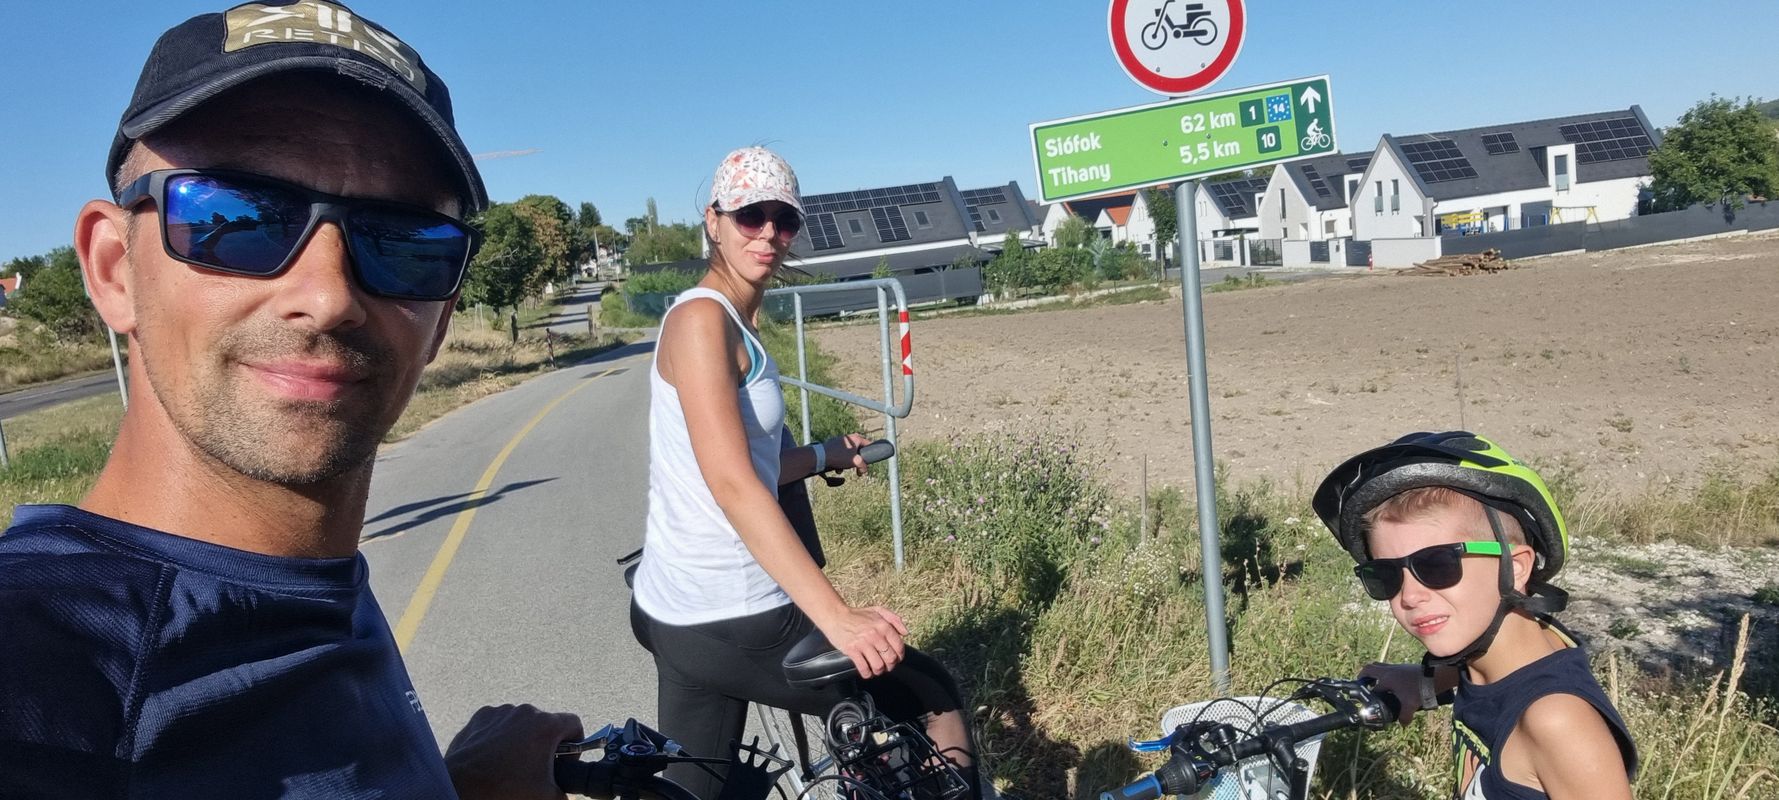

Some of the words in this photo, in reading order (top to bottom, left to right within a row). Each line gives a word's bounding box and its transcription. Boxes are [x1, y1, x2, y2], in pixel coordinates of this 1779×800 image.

[243, 27, 415, 82] RETRO
[1249, 105, 1256, 120] 1
[1272, 102, 1286, 114] 14
[1045, 132, 1102, 157] Siófok
[1181, 113, 1206, 134] 62
[1209, 111, 1236, 130] km
[1261, 132, 1277, 149] 10
[1048, 163, 1111, 187] Tihany
[1179, 142, 1211, 165] 5,5
[1213, 140, 1241, 158] km
